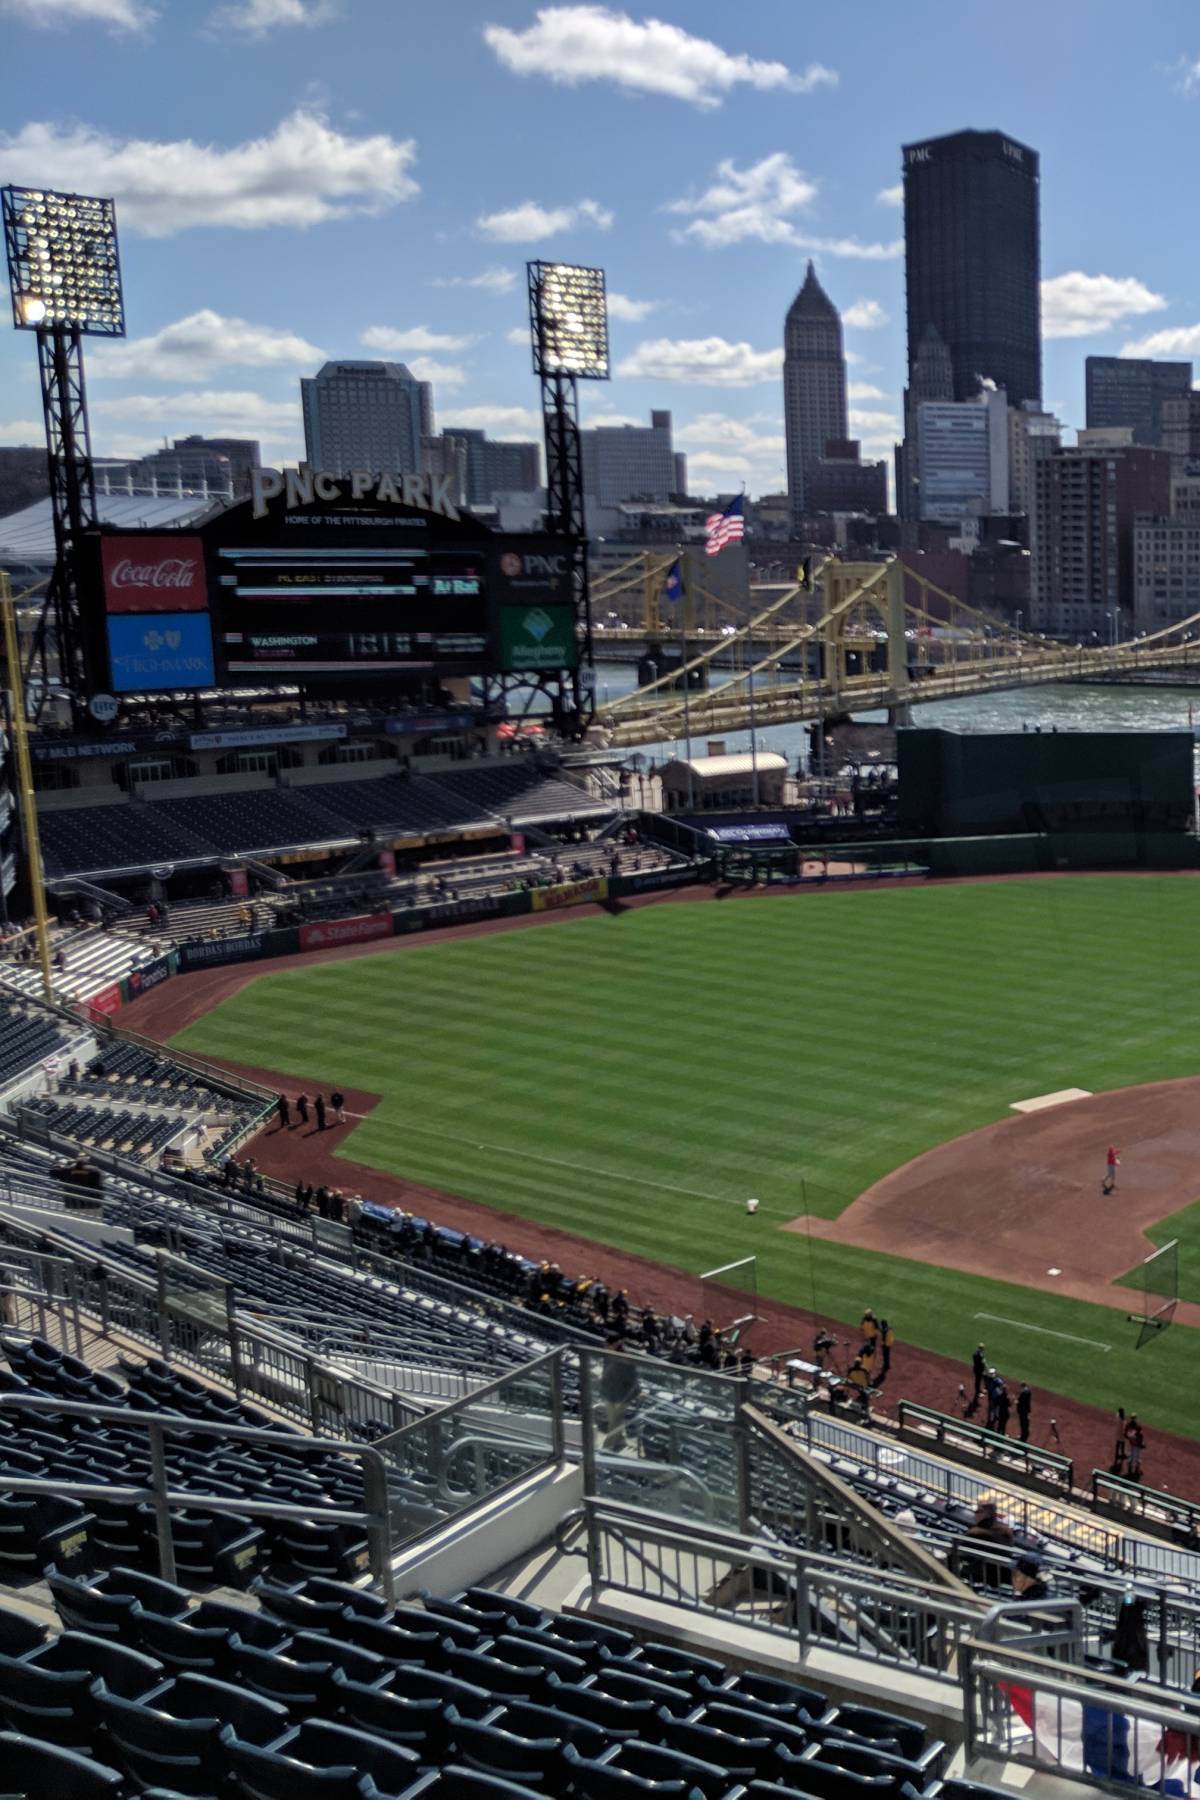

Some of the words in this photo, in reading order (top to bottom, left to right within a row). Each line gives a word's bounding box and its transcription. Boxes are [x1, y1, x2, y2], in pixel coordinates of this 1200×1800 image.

[251, 467, 344, 520] PNC
[350, 471, 463, 523] PARK
[285, 514, 311, 526] HOME
[312, 515, 324, 526] OF
[325, 516, 341, 526] THE
[110, 558, 198, 589] Coca-Cola
[523, 554, 567, 575] PNC
[250, 635, 319, 647] WASHINGTON
[79, 741, 138, 756] NETWORK
